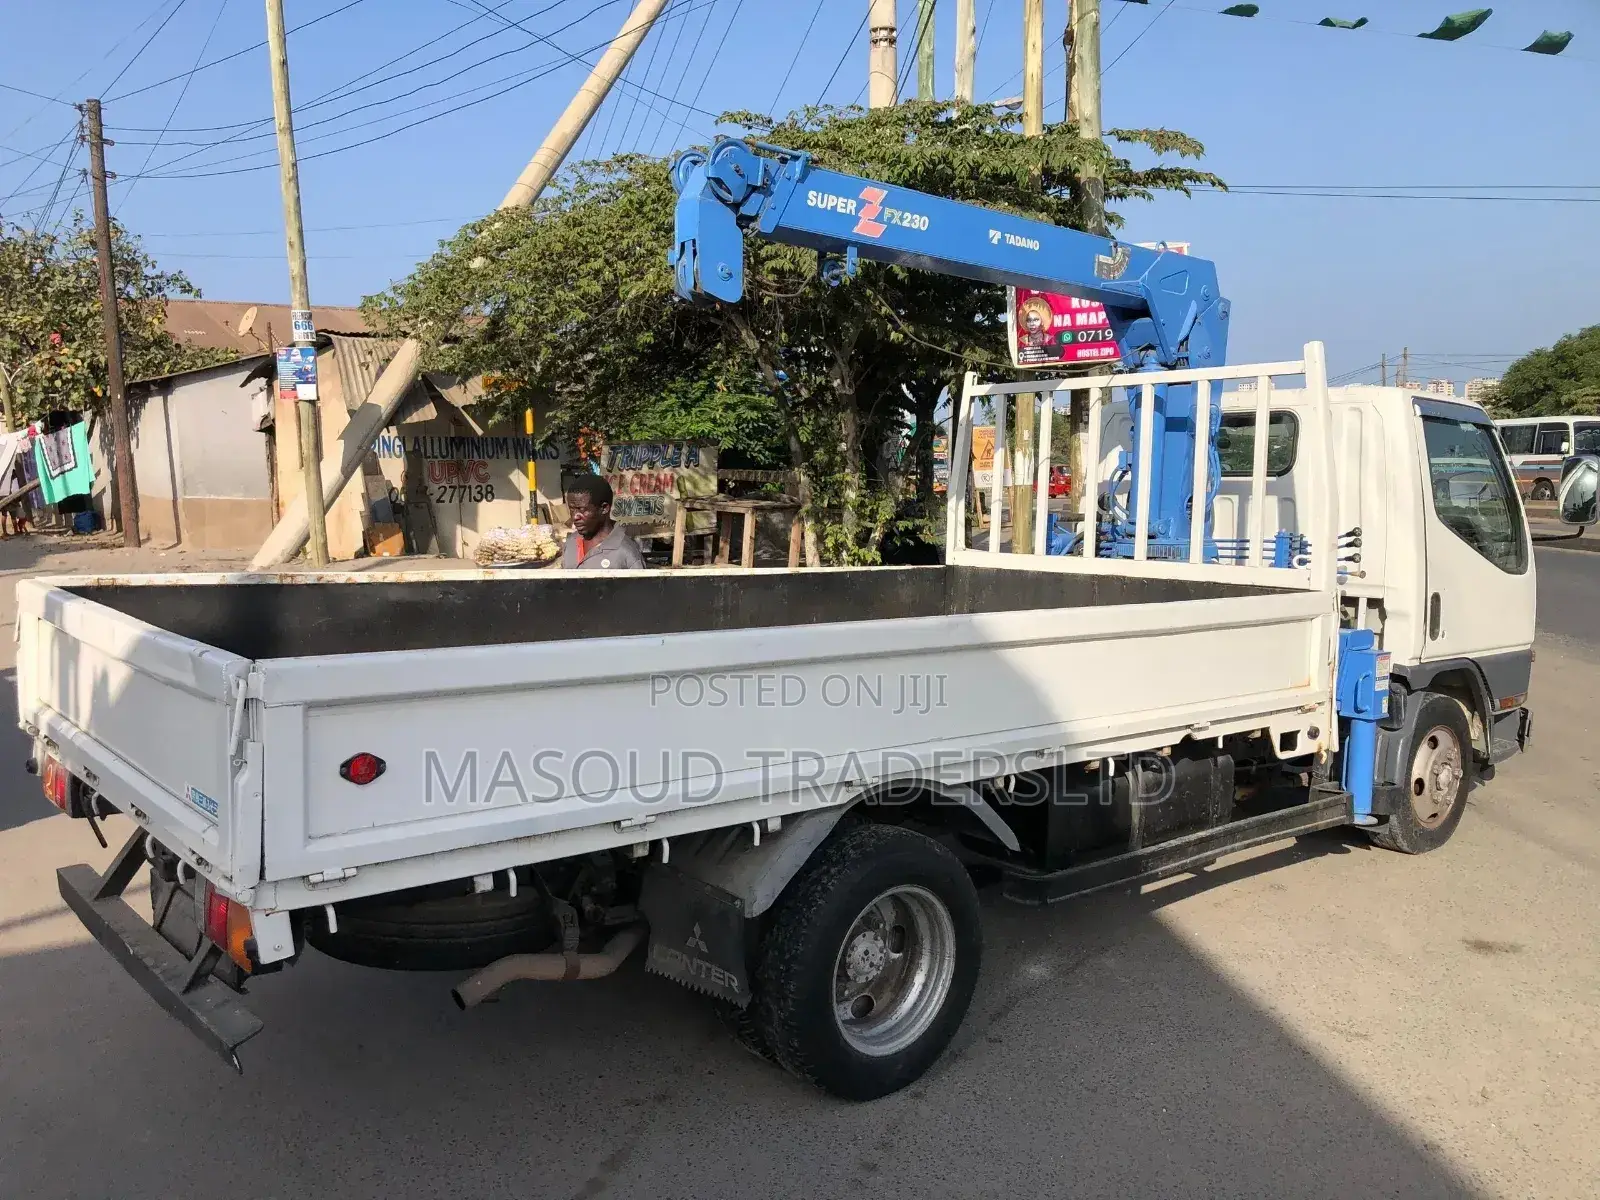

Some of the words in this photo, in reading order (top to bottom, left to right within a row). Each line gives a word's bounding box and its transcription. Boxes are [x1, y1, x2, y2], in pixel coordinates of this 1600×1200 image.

[806, 190, 857, 216] SUPER
[883, 206, 930, 231] FX230
[1004, 232, 1040, 251] TADANO
[1071, 297, 1104, 309] KU
[294, 320, 314, 331] 666
[1053, 313, 1072, 328] NA
[1075, 310, 1110, 326] MAP
[1077, 328, 1114, 343] 0719
[1076, 348, 1099, 358] HOSTEL
[412, 436, 510, 460] ALLUMINIUM
[606, 444, 684, 473] TRIPPLE
[685, 445, 700, 469] A
[428, 460, 492, 484] UPVC
[629, 472, 675, 495] CREAM
[389, 484, 496, 504] 0-277138
[613, 496, 666, 517] SWEETS
